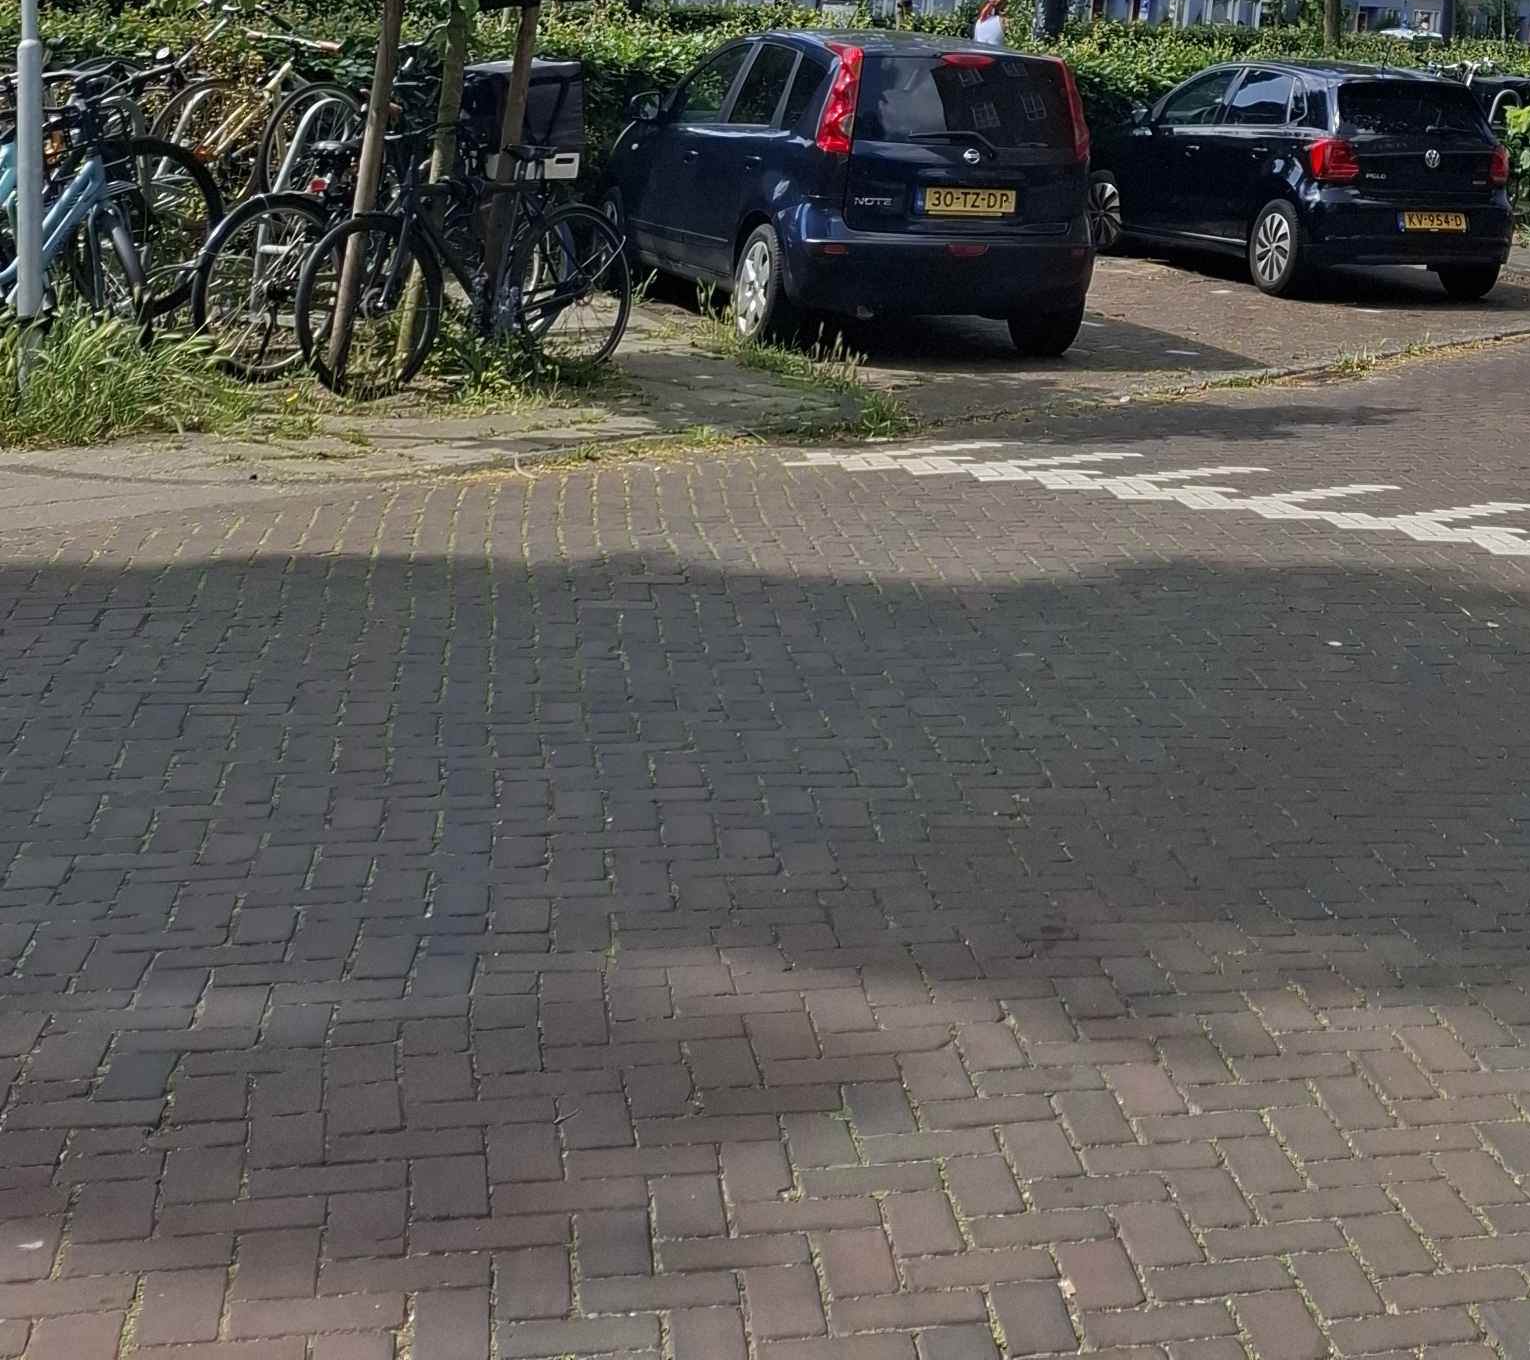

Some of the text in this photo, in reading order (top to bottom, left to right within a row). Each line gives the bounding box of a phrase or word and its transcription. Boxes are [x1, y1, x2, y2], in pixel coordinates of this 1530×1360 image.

[854, 197, 893, 206] NOTE
[931, 190, 1010, 209] 30-TZ-DP
[1407, 214, 1463, 227] KV-954-D
